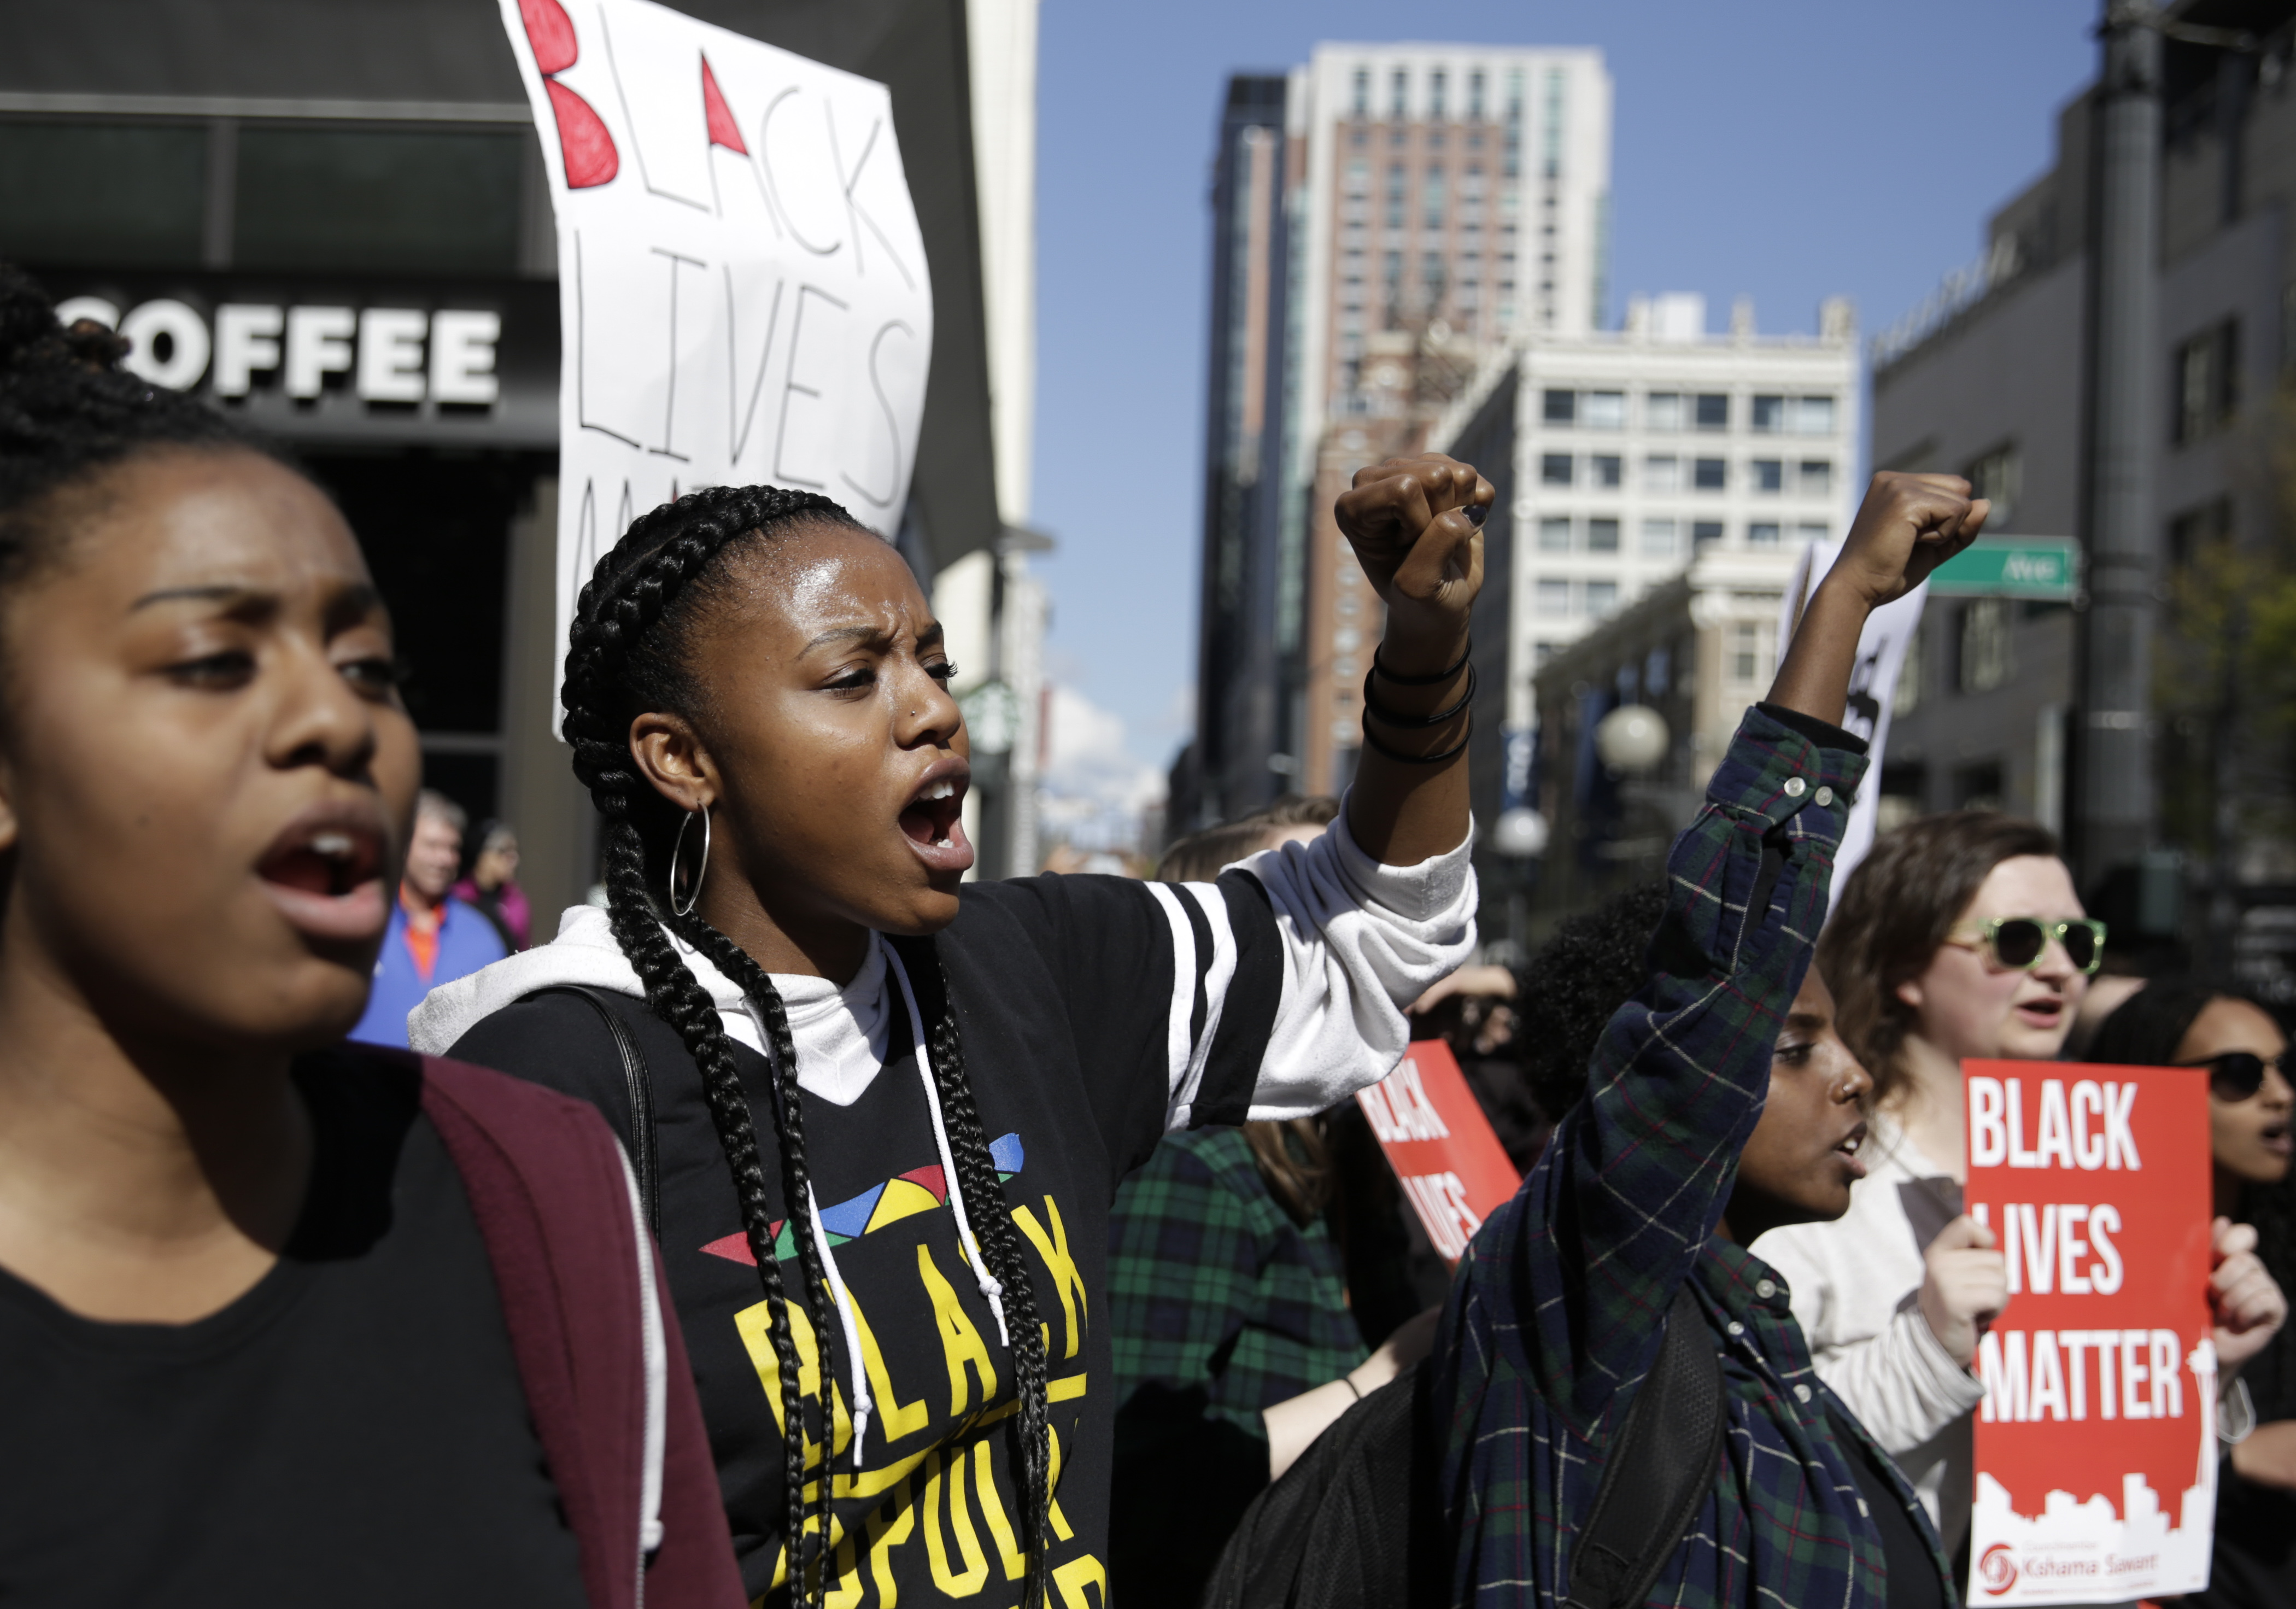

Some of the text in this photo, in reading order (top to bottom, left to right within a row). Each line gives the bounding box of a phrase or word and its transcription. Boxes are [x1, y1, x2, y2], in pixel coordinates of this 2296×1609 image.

[516, 0, 916, 292] BLACK
[575, 228, 916, 509] LIVES
[1358, 1058, 1450, 1142] BLACK
[1969, 1076, 2142, 1171] BLACK
[734, 1195, 1088, 1471] BLAK
[1978, 1329, 2184, 1422] MATTER
[2023, 1552, 2159, 1579] Kshama Sawant
